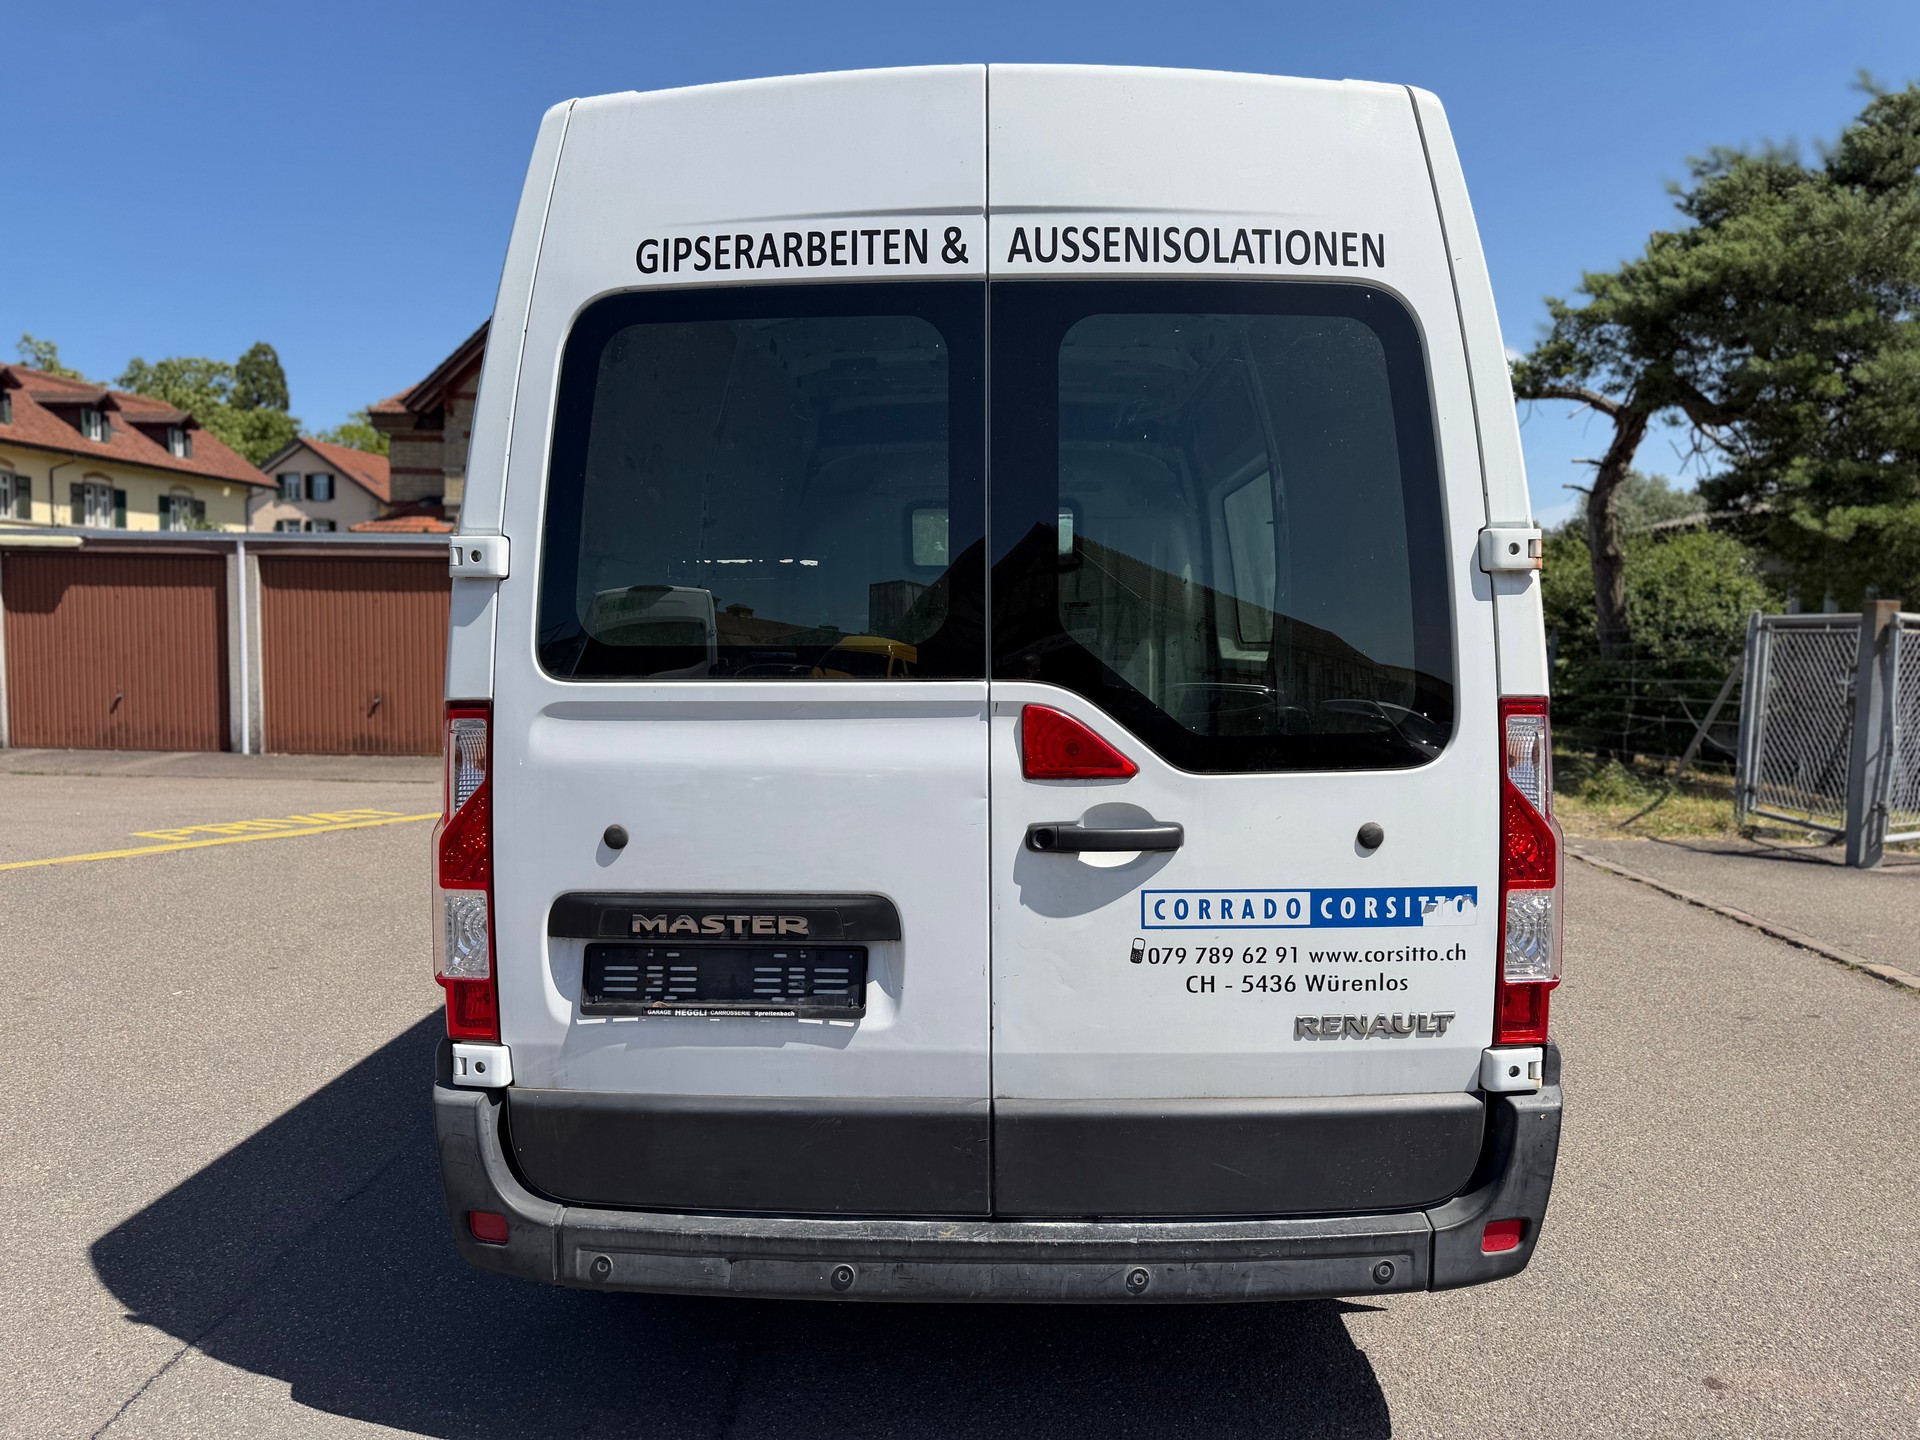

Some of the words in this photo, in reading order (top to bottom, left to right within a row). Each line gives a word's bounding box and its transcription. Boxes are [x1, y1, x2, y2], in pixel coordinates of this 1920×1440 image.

[635, 228, 928, 274] GIPSERARBEITEN
[941, 226, 969, 264] &
[1007, 226, 1385, 268] AUSSENISOLATIONEN
[1154, 898, 1301, 920] CORRADO
[632, 914, 809, 935] MASTER
[1148, 947, 1187, 965] 079
[1195, 946, 1234, 965] 789
[1242, 946, 1268, 965] 62
[1275, 946, 1298, 964] 91
[1308, 943, 1466, 963] www.corsitto.ch
[1185, 975, 1216, 994] CH
[1241, 974, 1297, 993] 5436
[1305, 973, 1409, 992] Würenlos
[674, 1009, 708, 1017] HEGGLI
[1295, 1011, 1456, 1036] RENAULT
